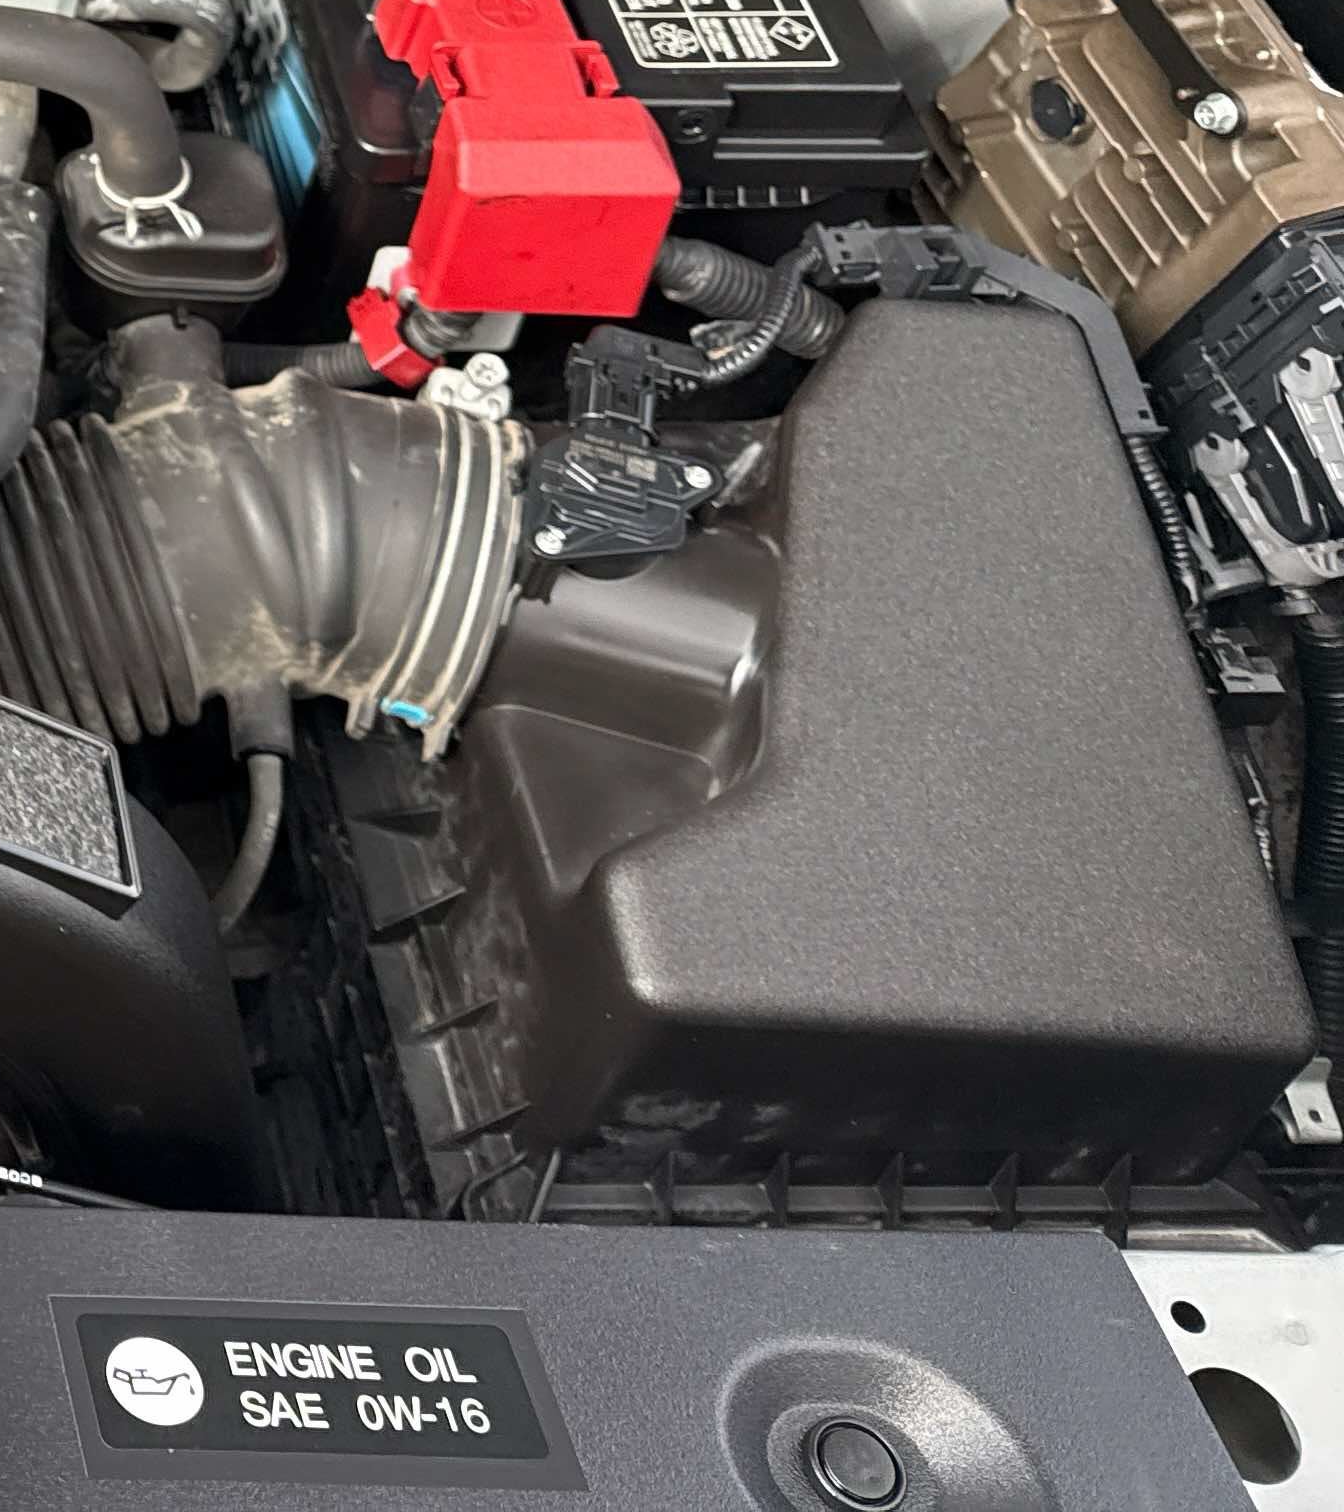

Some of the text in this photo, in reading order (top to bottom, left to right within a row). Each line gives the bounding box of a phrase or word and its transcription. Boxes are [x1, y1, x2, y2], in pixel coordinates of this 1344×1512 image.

[223, 1341, 479, 1383] ENGINE OIL
[239, 1390, 491, 1435] SAE 0W-16
